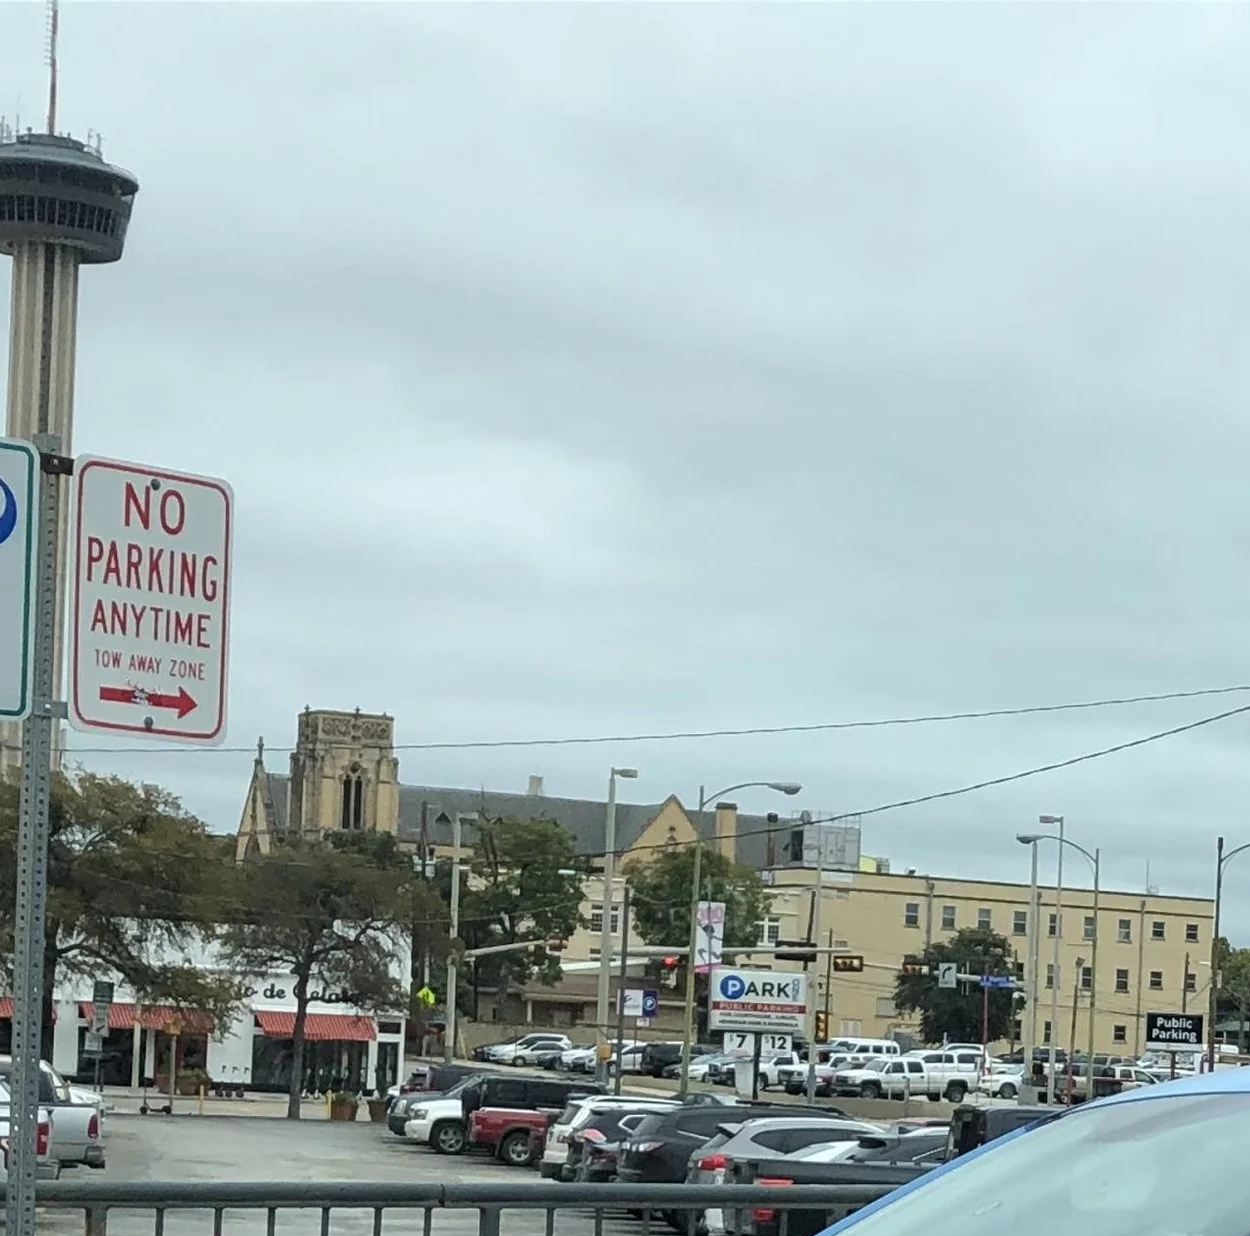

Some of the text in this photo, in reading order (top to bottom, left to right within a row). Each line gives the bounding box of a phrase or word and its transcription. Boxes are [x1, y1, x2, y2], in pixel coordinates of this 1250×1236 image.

[124, 481, 186, 536] NO
[86, 535, 218, 602] PARKING
[90, 598, 212, 649] ANYTIME
[94, 648, 206, 681] TOW AWAY ZONE
[262, 983, 287, 999] de
[720, 976, 790, 999] PARK
[719, 1001, 754, 1011] PUBLIC
[1156, 1016, 1193, 1029] Public
[1151, 1027, 1198, 1043] Parking
